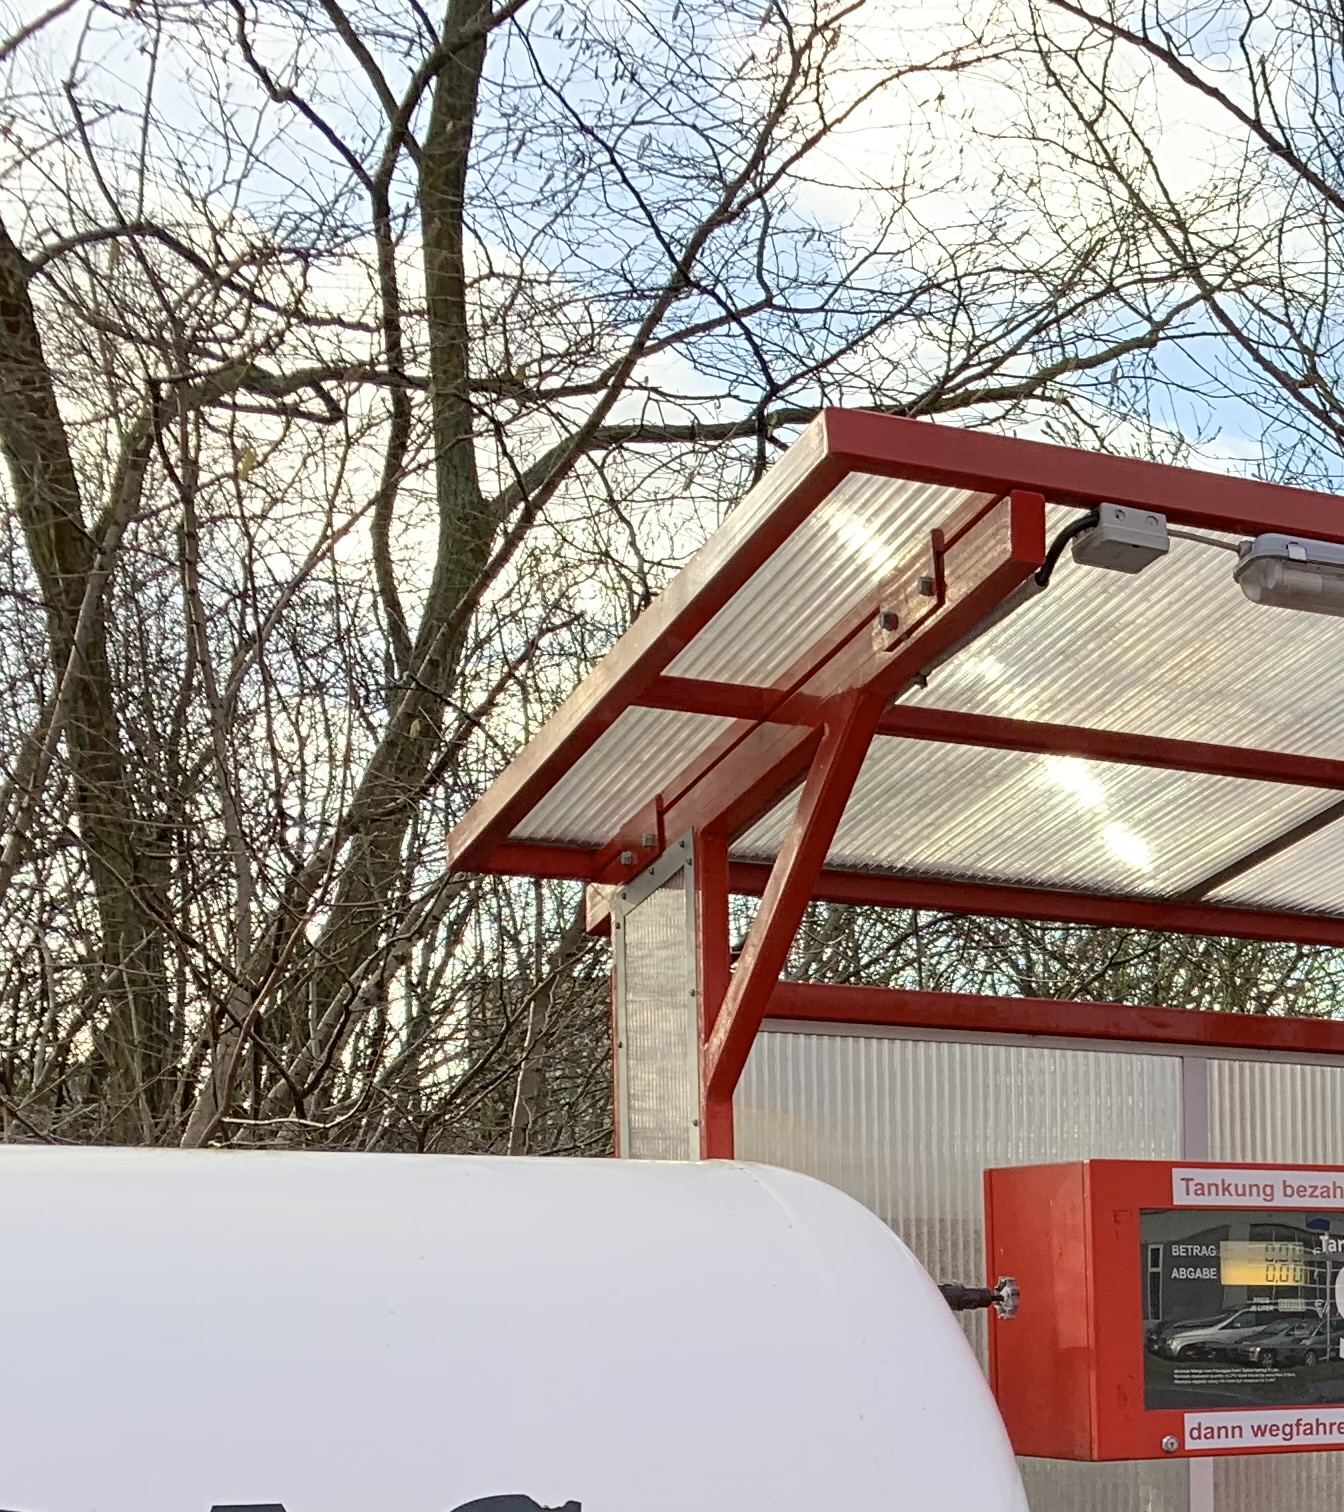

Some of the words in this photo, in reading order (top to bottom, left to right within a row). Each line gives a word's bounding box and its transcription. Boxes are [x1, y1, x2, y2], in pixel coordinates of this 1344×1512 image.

[1180, 1177, 1275, 1202] Tankung
[1171, 1244, 1217, 1257] BETRAG
[1171, 1267, 1218, 1280] ABGABE
[1265, 1263, 1303, 1283] 0,00
[1188, 1422, 1243, 1441] dann
